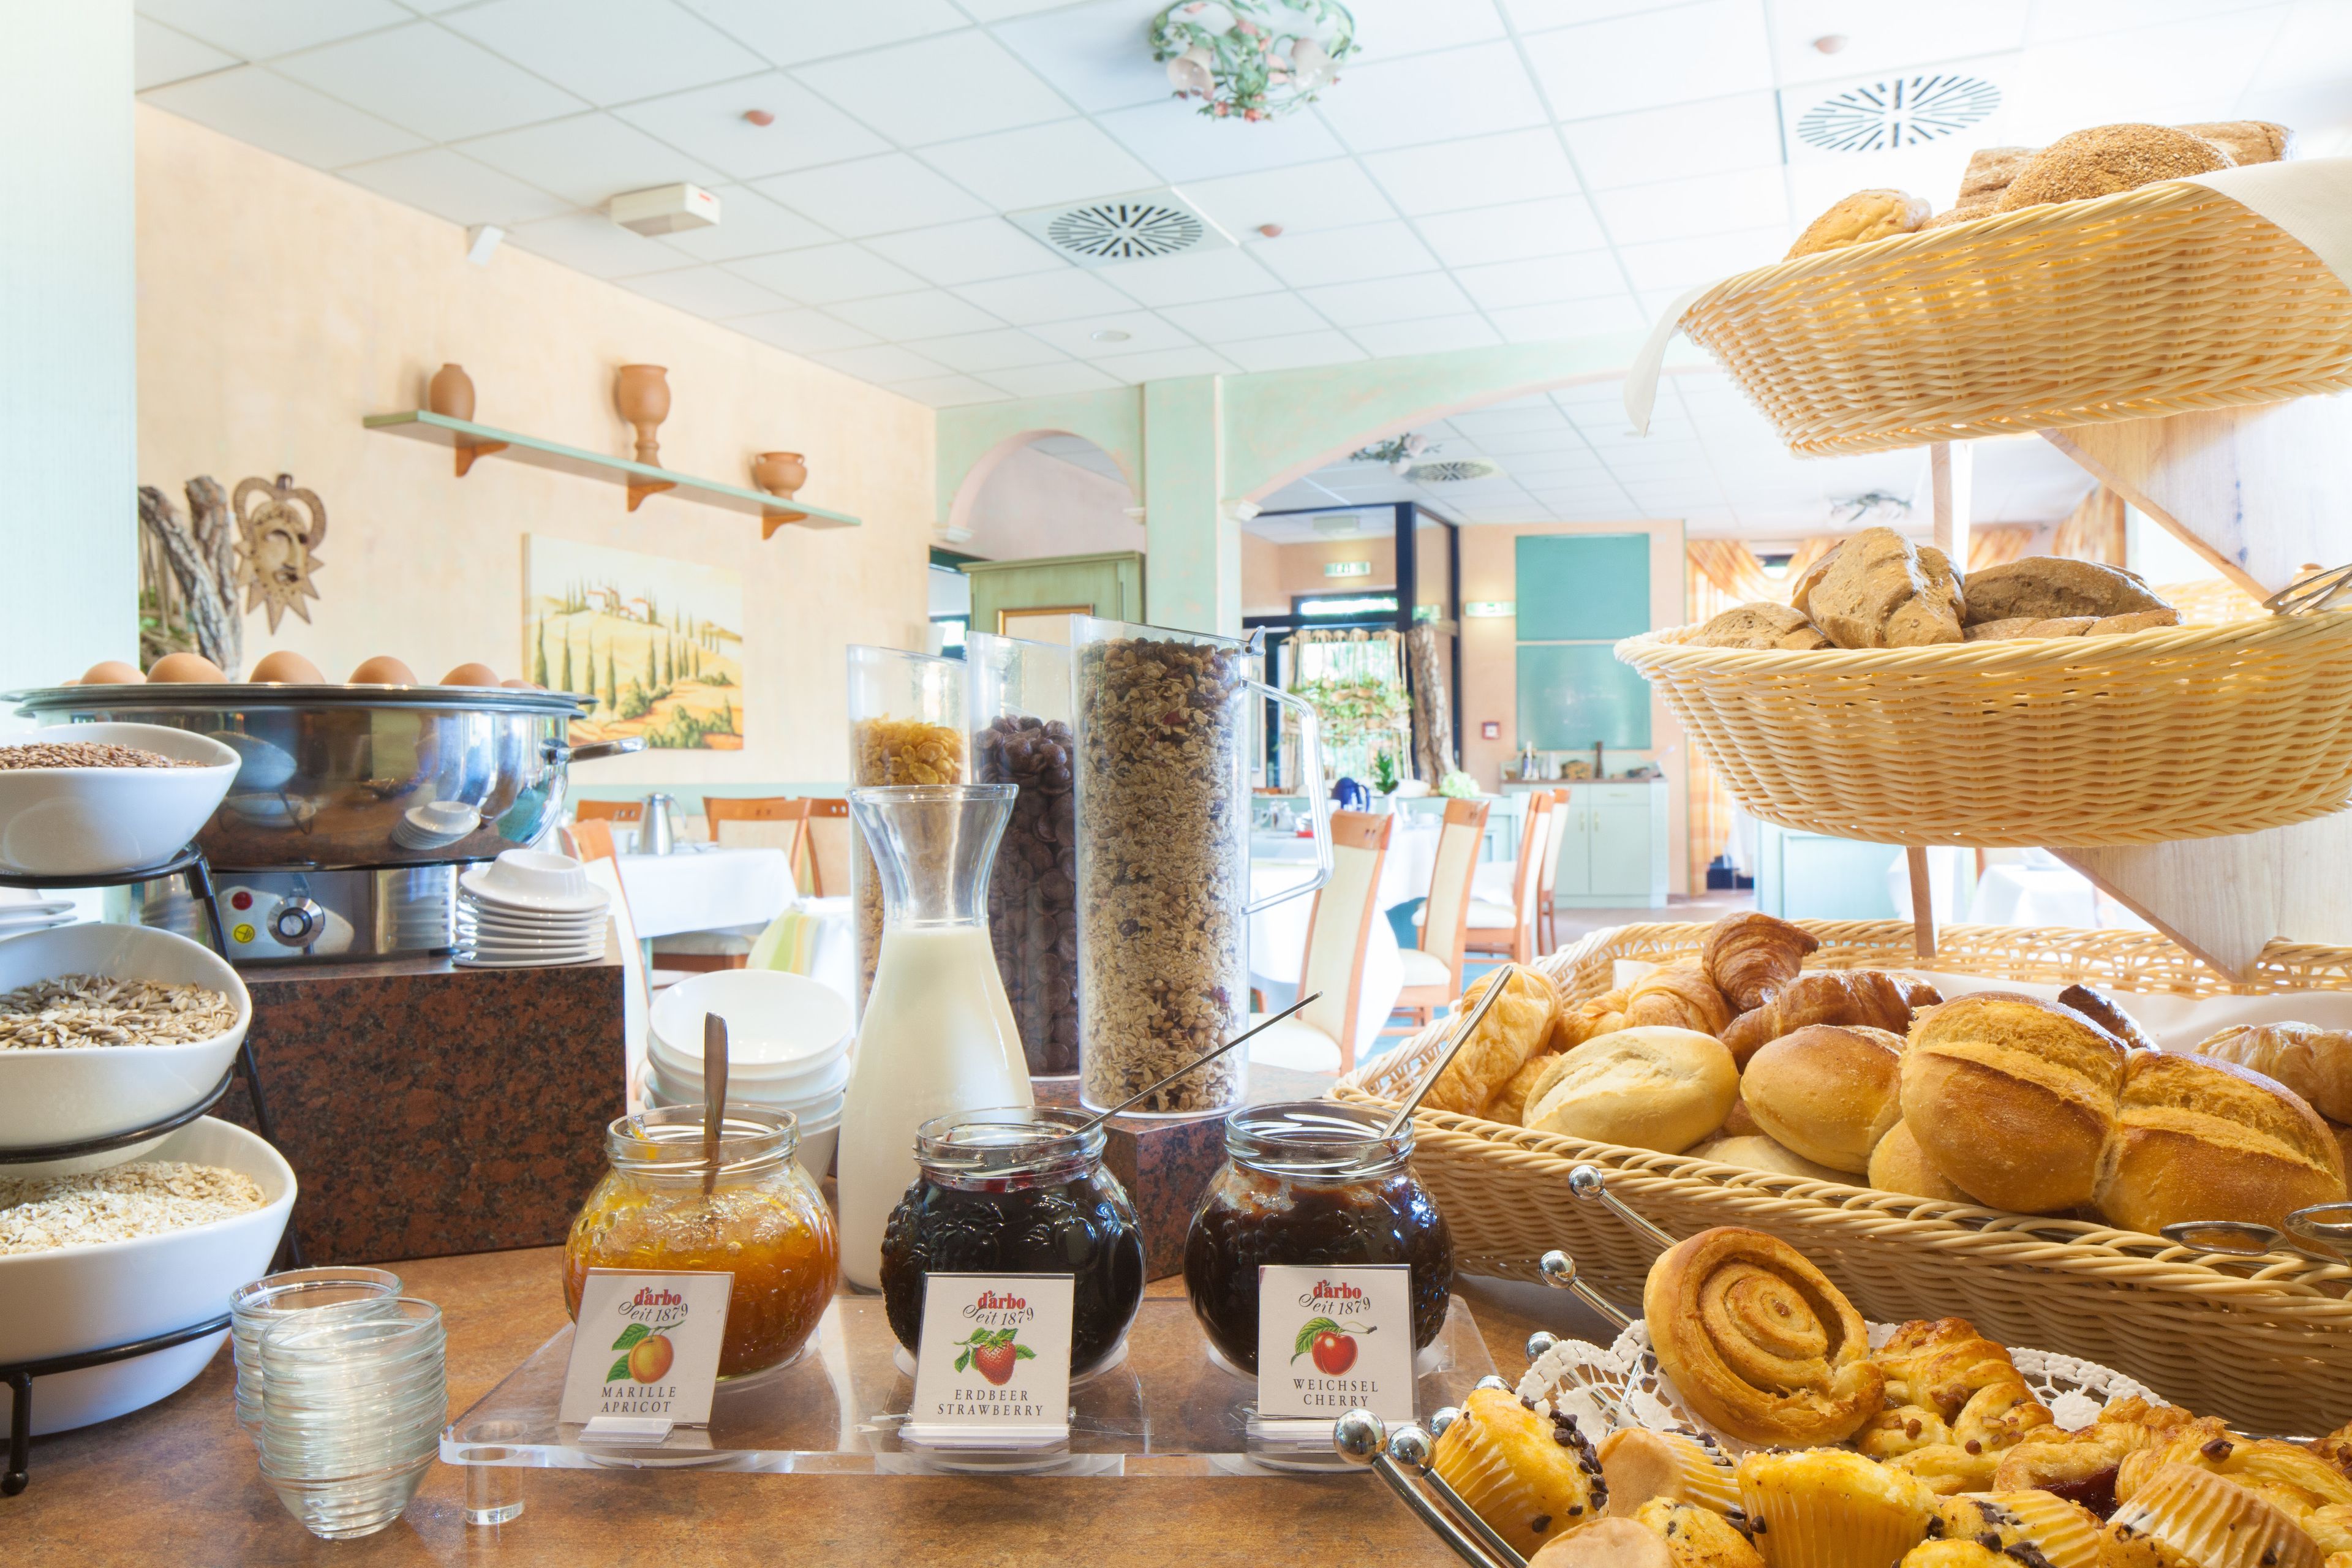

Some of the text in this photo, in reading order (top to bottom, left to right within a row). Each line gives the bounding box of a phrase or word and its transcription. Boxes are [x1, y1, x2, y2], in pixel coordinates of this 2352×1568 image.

[1298, 1294, 1370, 1315] Seit 1879
[618, 1301, 688, 1322] Seit 1879
[962, 1304, 1034, 1325] Seit 1879
[1293, 1379, 1378, 1392] WEICHSEL
[601, 1387, 676, 1398] MARILLE
[955, 1390, 1028, 1400] ERDBEER
[1303, 1394, 1368, 1406] CHERRY
[601, 1401, 671, 1412] APRICOT
[938, 1404, 1044, 1416] STRAWBERRY
